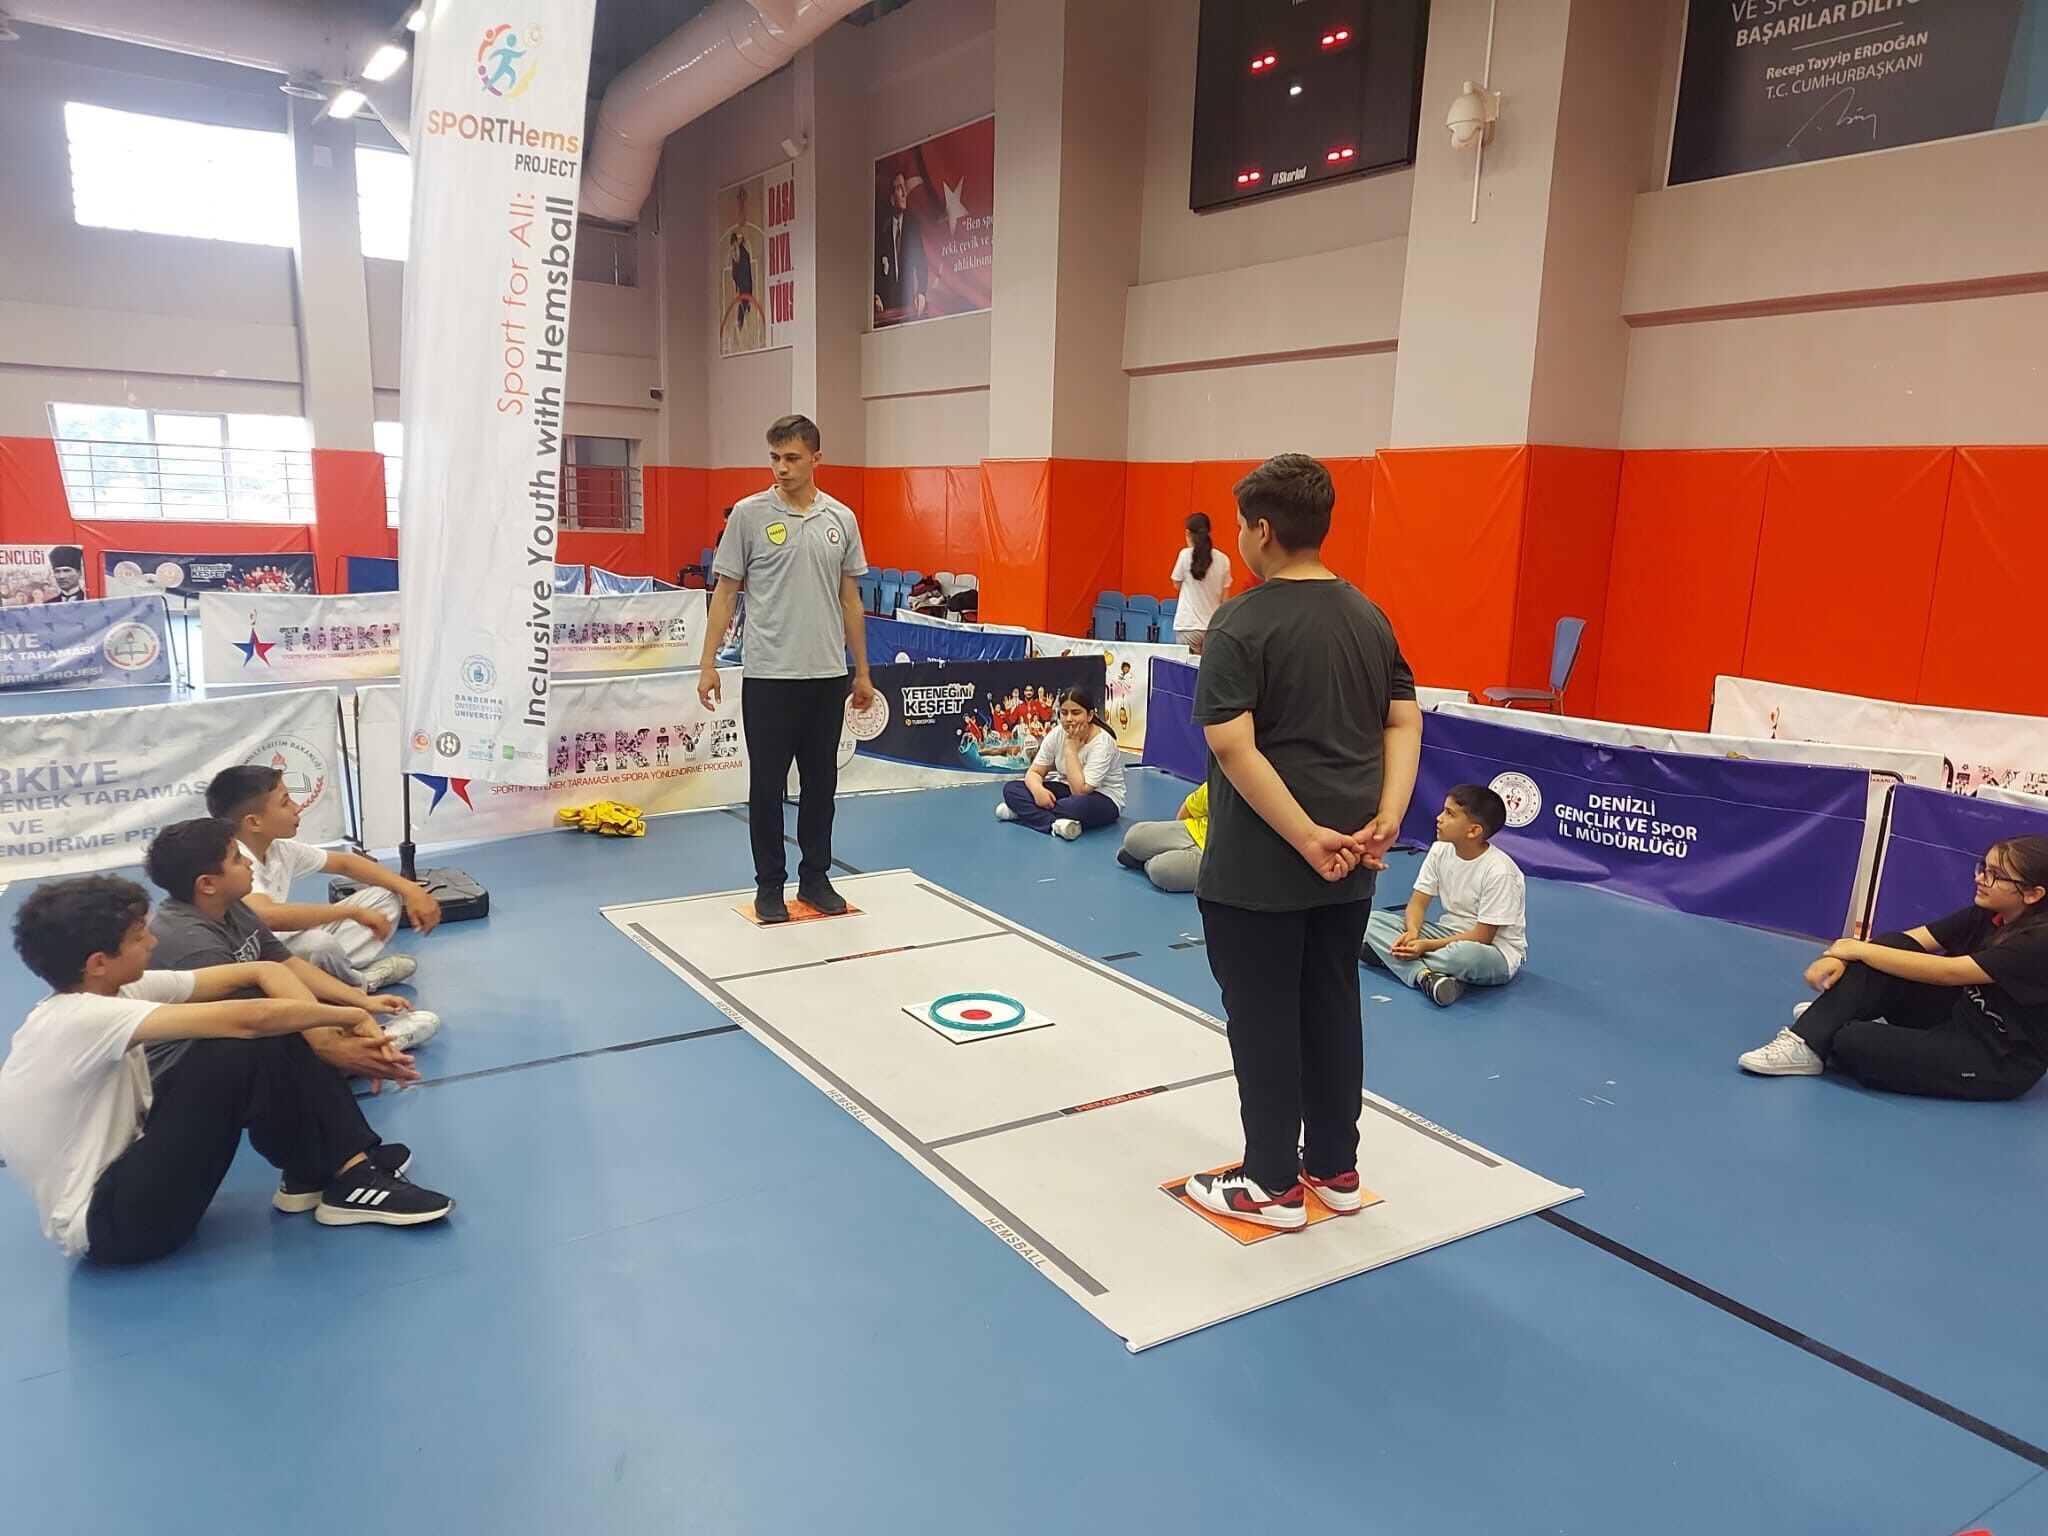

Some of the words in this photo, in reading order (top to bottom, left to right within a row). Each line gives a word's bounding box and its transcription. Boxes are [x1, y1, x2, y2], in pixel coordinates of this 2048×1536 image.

[1736, 4, 1846, 47] BAŞARILAR
[1765, 83, 1789, 99] T.C.
[1791, 53, 1924, 94] CUMHURBAŞKANI
[1766, 63, 1804, 80] Recep
[1808, 51, 1851, 72] Tayyip
[1854, 31, 1928, 60] ERDOĞAN
[427, 109, 579, 154] SPORTHems
[515, 153, 577, 178] PROJECT
[509, 192, 536, 248] All:
[503, 257, 529, 307] for
[536, 196, 573, 372] Hemsball
[496, 320, 529, 416] Sport
[533, 386, 561, 457] with
[527, 469, 556, 566] Youth
[523, 580, 552, 727] Inclusive
[454, 709, 502, 721] UNIVERSITY
[905, 699, 963, 718] KEŞFET
[80, 780, 208, 806] TARAMAS
[568, 774, 609, 789] TARAMASI
[622, 772, 649, 782] SPORA
[704, 759, 743, 772] PROGRAMI
[1555, 804, 1621, 829] GENÇLİK
[1625, 817, 1647, 834] VE
[1651, 821, 1697, 841] SPOR
[1588, 793, 1656, 816] DENİZLİ
[8, 819, 43, 835] VE
[1559, 820, 1572, 837] İL
[1576, 827, 1687, 858] MÜDÜRLÜĞÜ
[826, 1089, 870, 1123] HEMSBALL
[1074, 1090, 1155, 1112] HEMSBALL
[984, 1217, 1047, 1269] HEMSBALL
